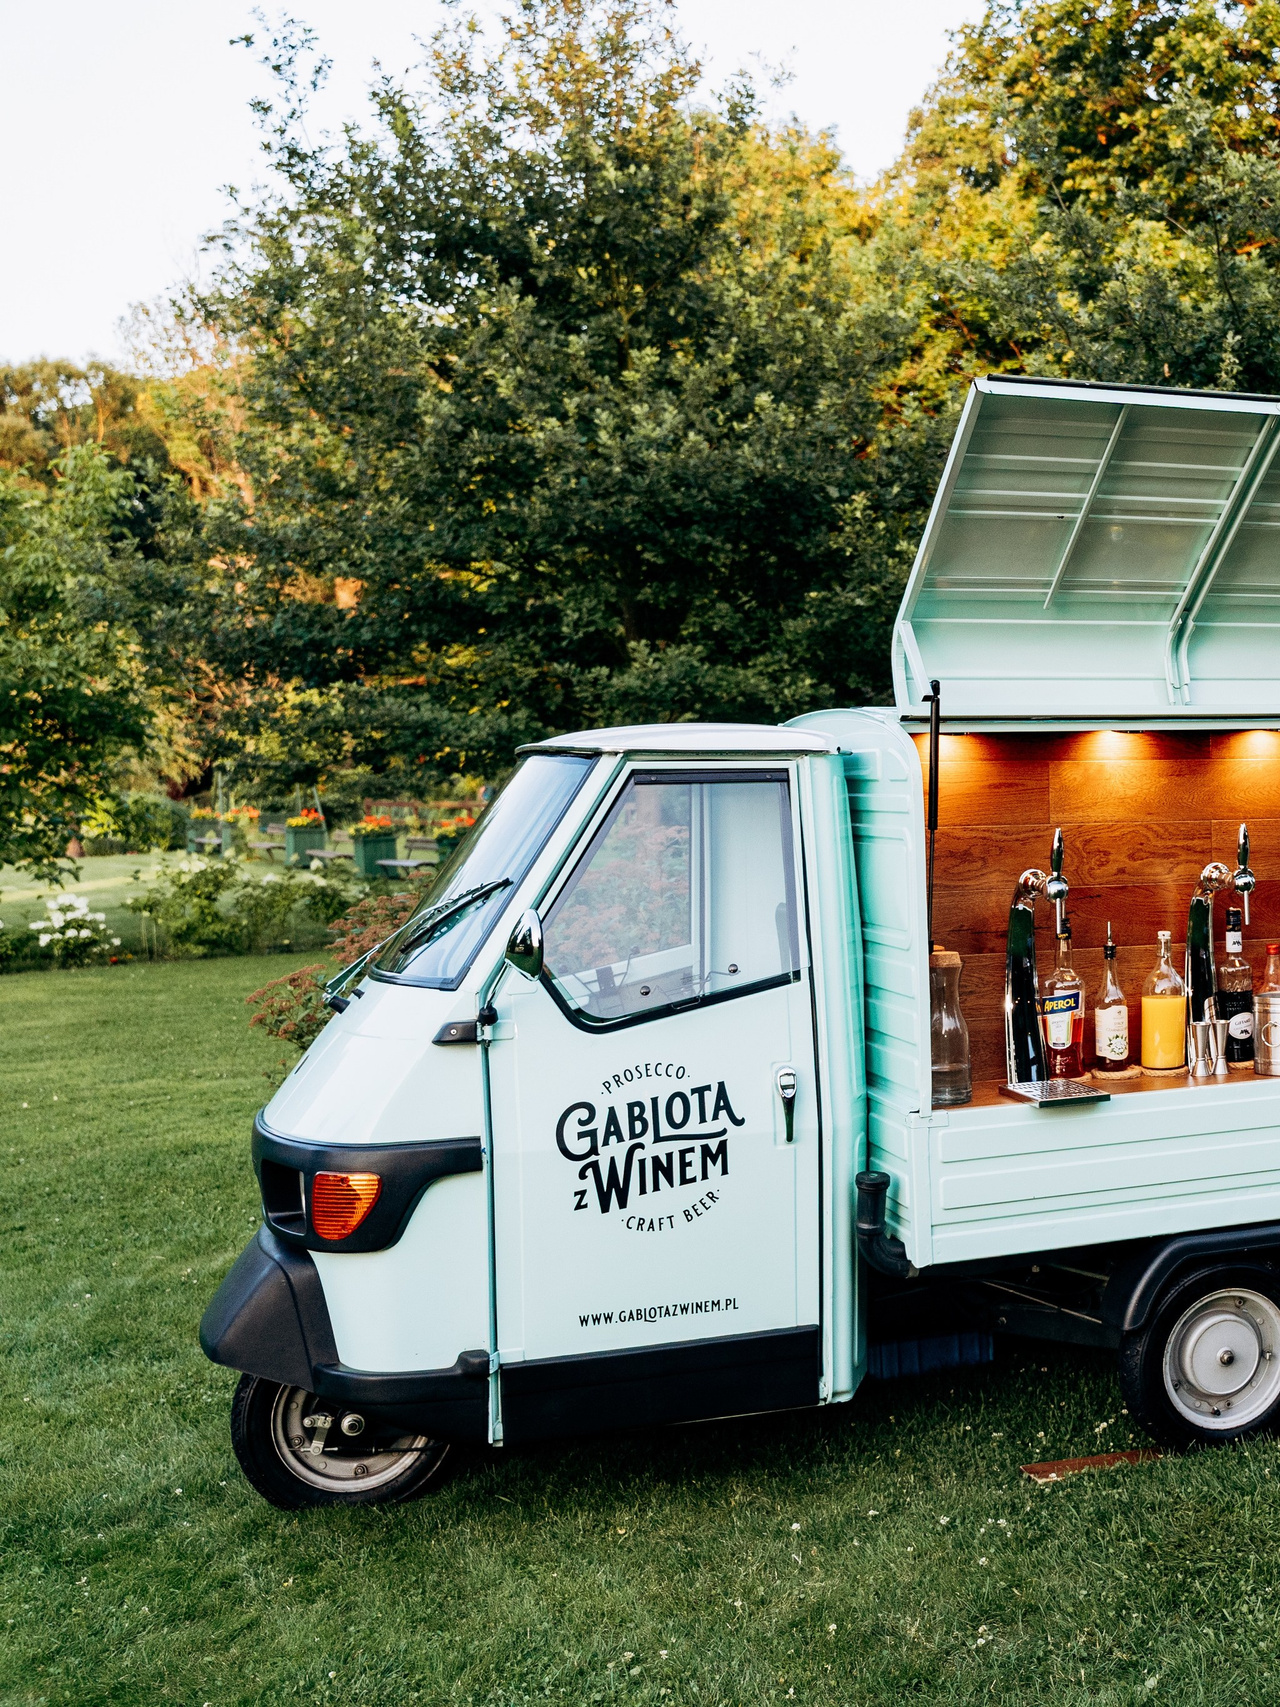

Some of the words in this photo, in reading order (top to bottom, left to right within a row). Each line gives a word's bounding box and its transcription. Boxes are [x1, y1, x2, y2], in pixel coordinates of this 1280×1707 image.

[1044, 998, 1076, 1012] APEROL
[603, 1063, 686, 1095] PROSECCO
[556, 1081, 746, 1161] GABLOTA
[579, 1139, 730, 1215] WINEM
[626, 1215, 675, 1232] CRAFT
[683, 1189, 720, 1223] BEER
[579, 1298, 739, 1328] WWW.GABLOTAZWINEM.PL
